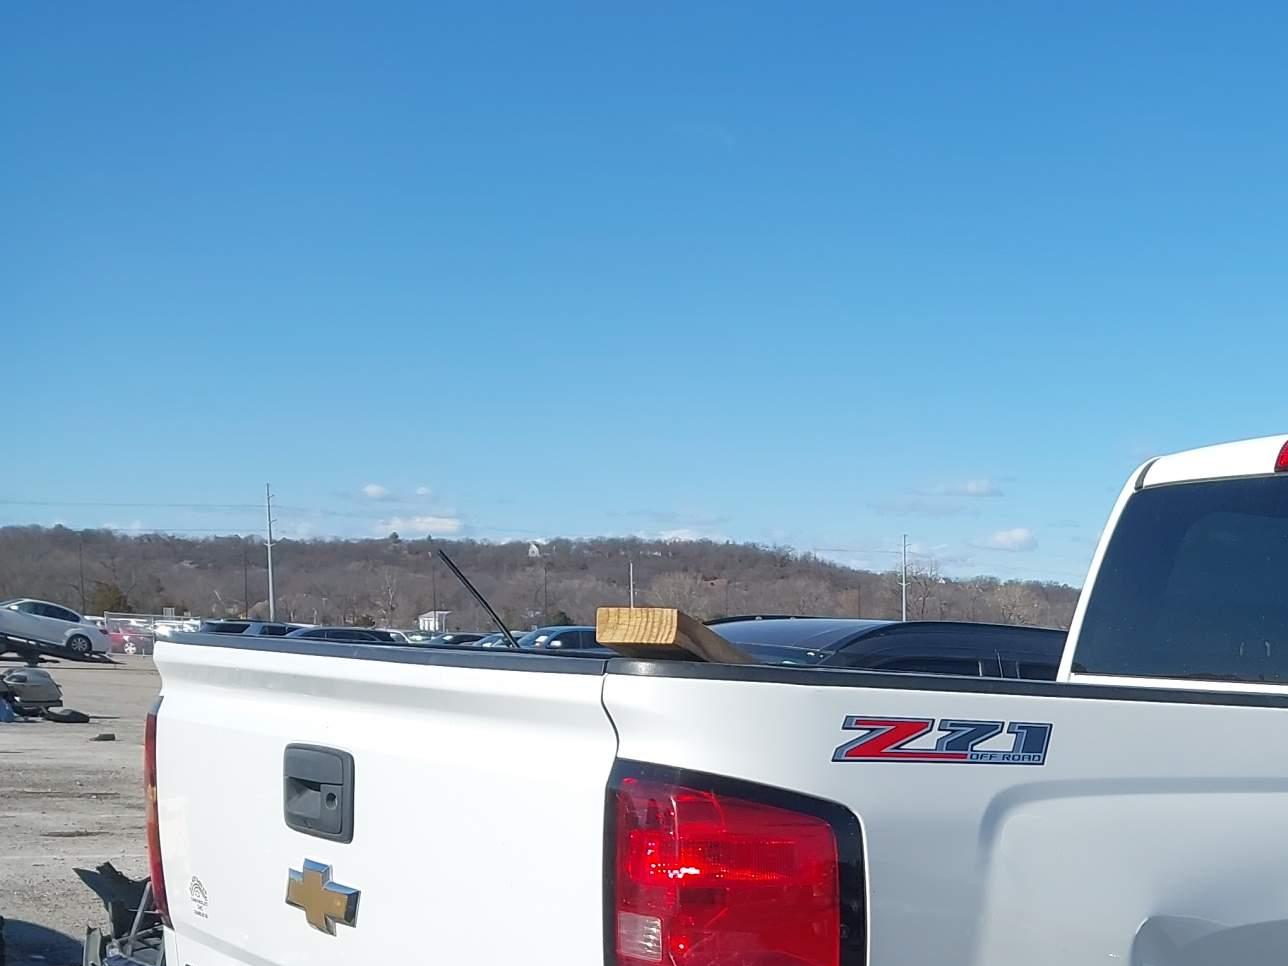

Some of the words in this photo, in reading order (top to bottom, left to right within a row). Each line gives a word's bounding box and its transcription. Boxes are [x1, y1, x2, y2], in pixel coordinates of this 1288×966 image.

[832, 715, 1053, 766] Z71
[969, 753, 998, 761] OFF
[1001, 753, 1042, 762] ROAD
